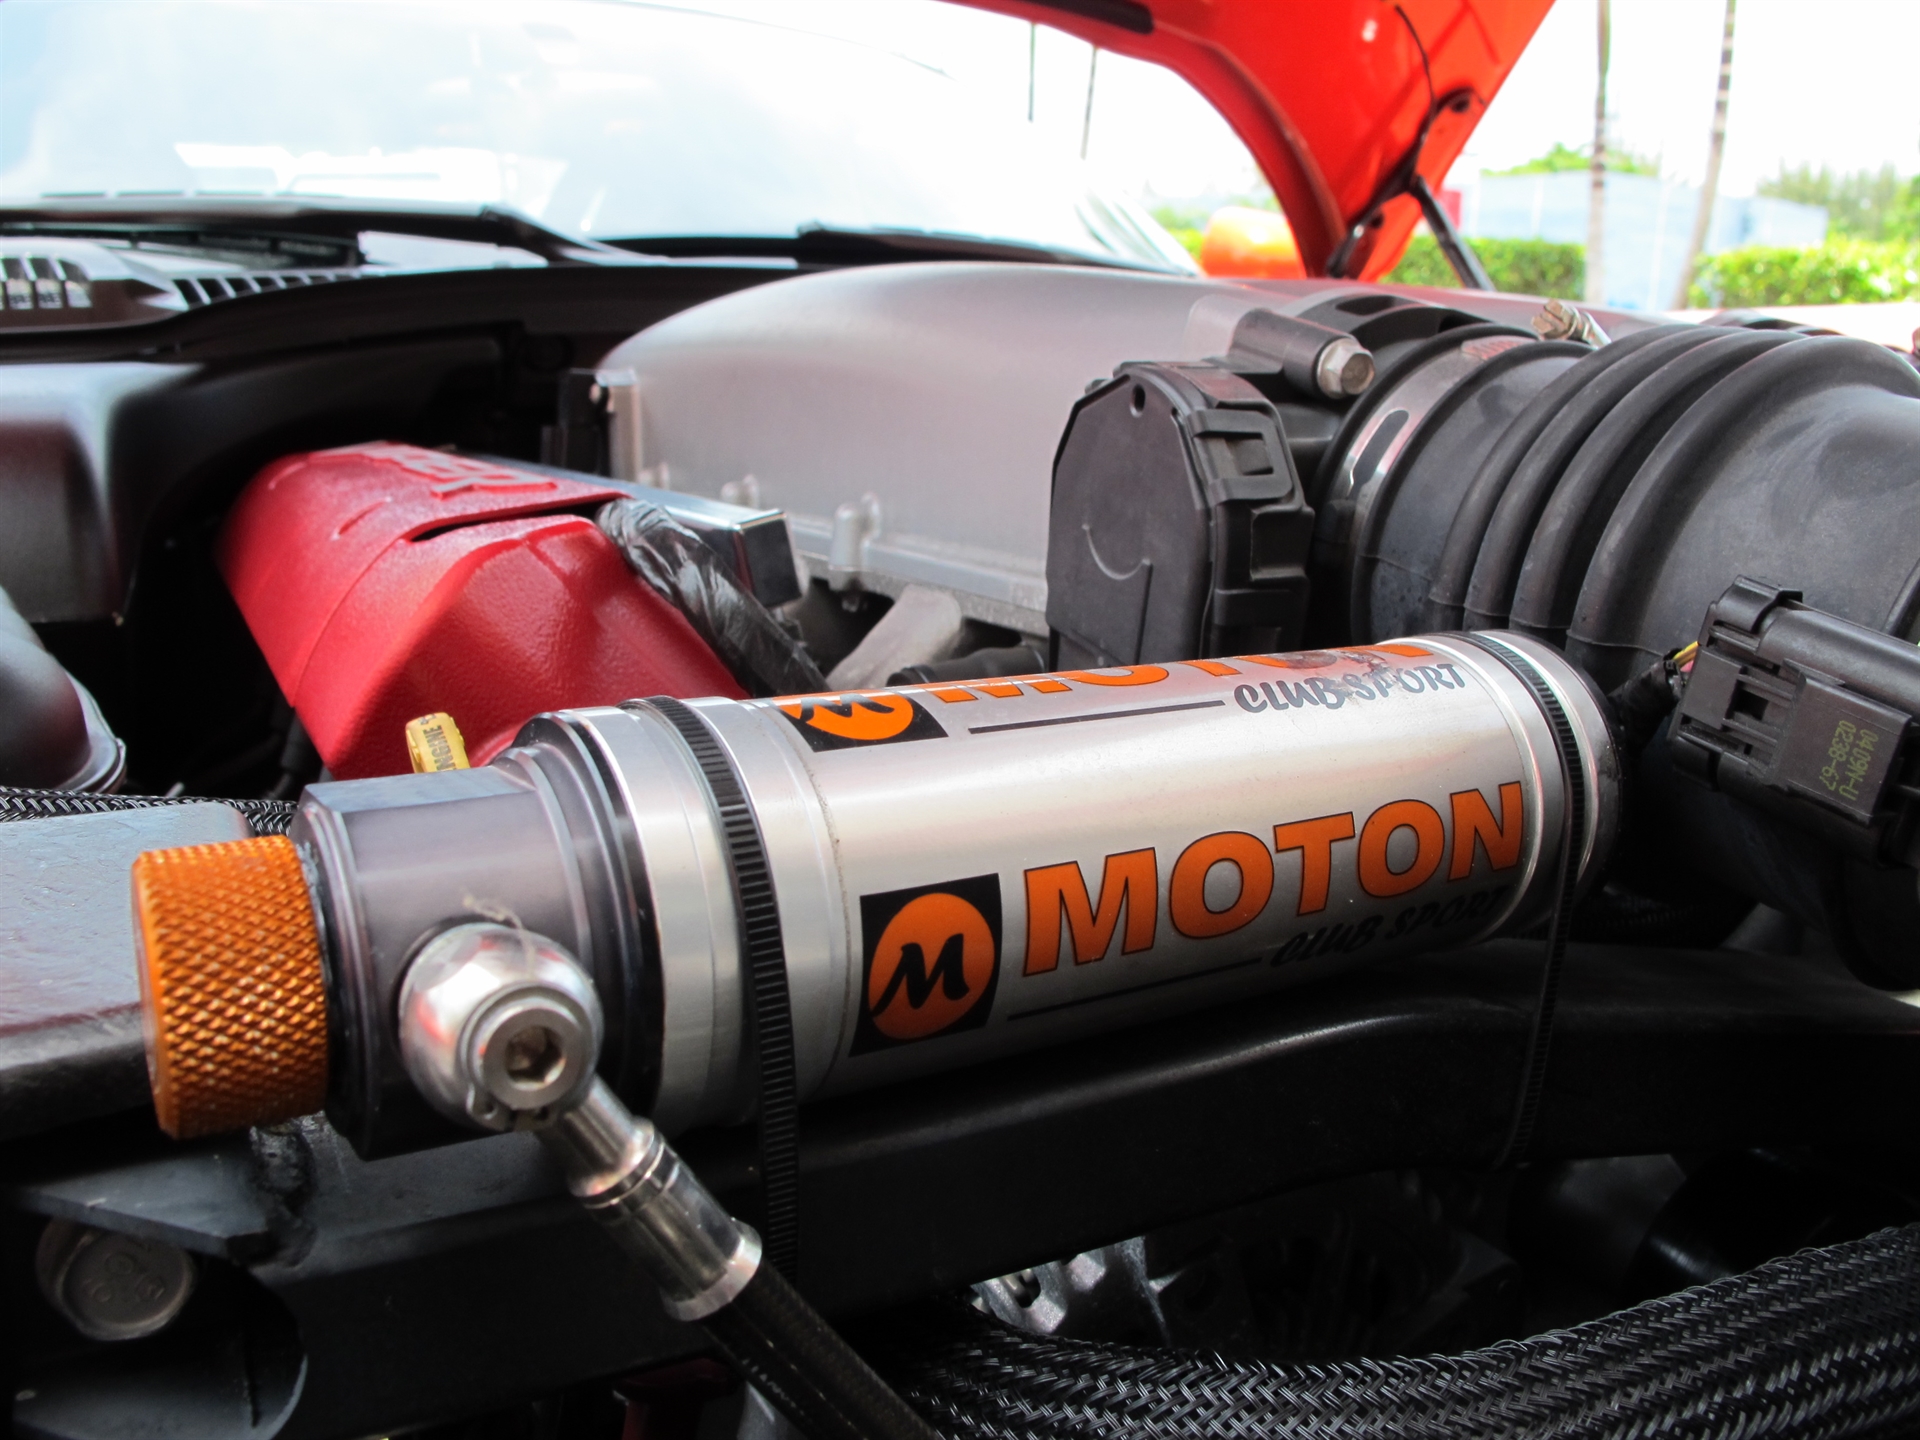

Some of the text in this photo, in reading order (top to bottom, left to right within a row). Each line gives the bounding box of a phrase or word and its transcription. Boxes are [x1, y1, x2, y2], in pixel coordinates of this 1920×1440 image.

[1233, 676, 1346, 714] CLUB
[1343, 662, 1467, 702] SPORT
[421, 724, 458, 772] NGINE
[1818, 720, 1857, 791] 0238-67
[1022, 780, 1525, 978] MOTON
[1269, 884, 1510, 968] CLUB SPORT
